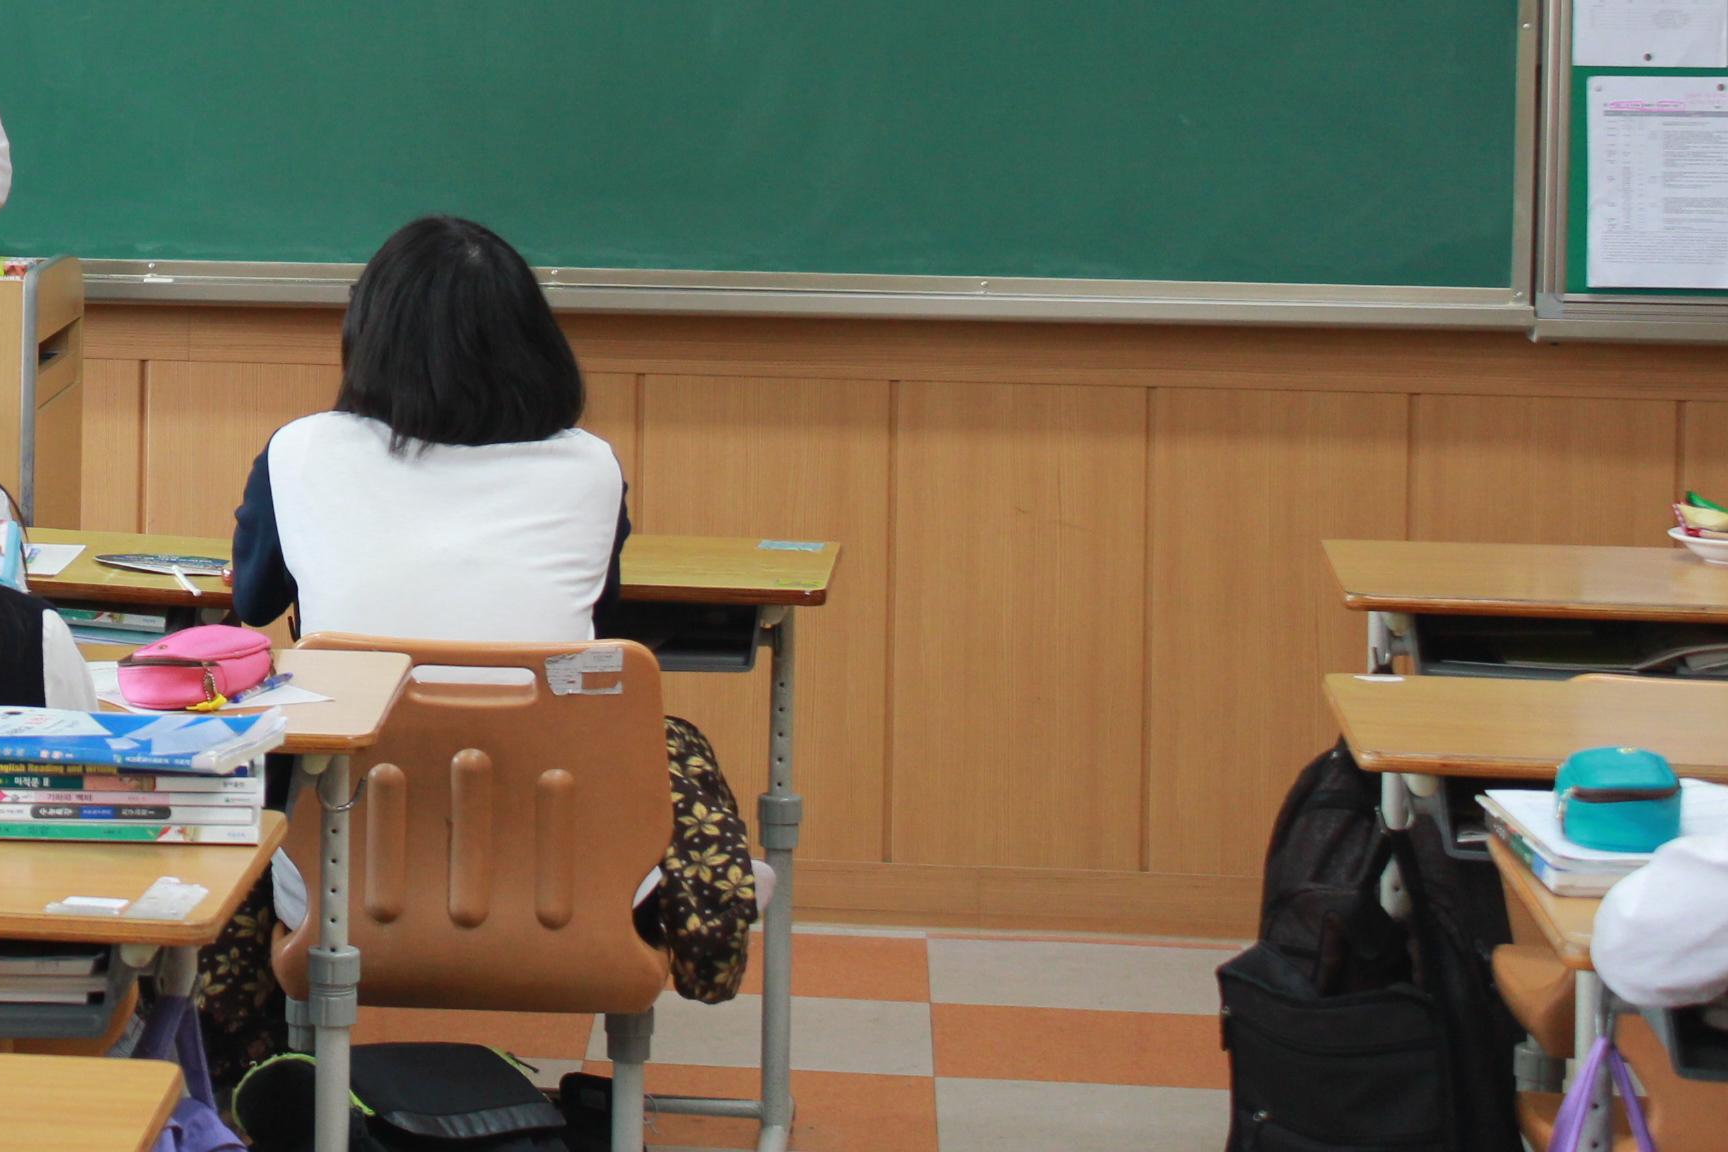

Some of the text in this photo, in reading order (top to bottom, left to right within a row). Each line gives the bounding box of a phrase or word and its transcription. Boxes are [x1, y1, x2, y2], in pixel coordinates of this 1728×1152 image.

[27, 763, 64, 774] Reading
[66, 764, 83, 774] and
[14, 776, 40, 788] 미적분
